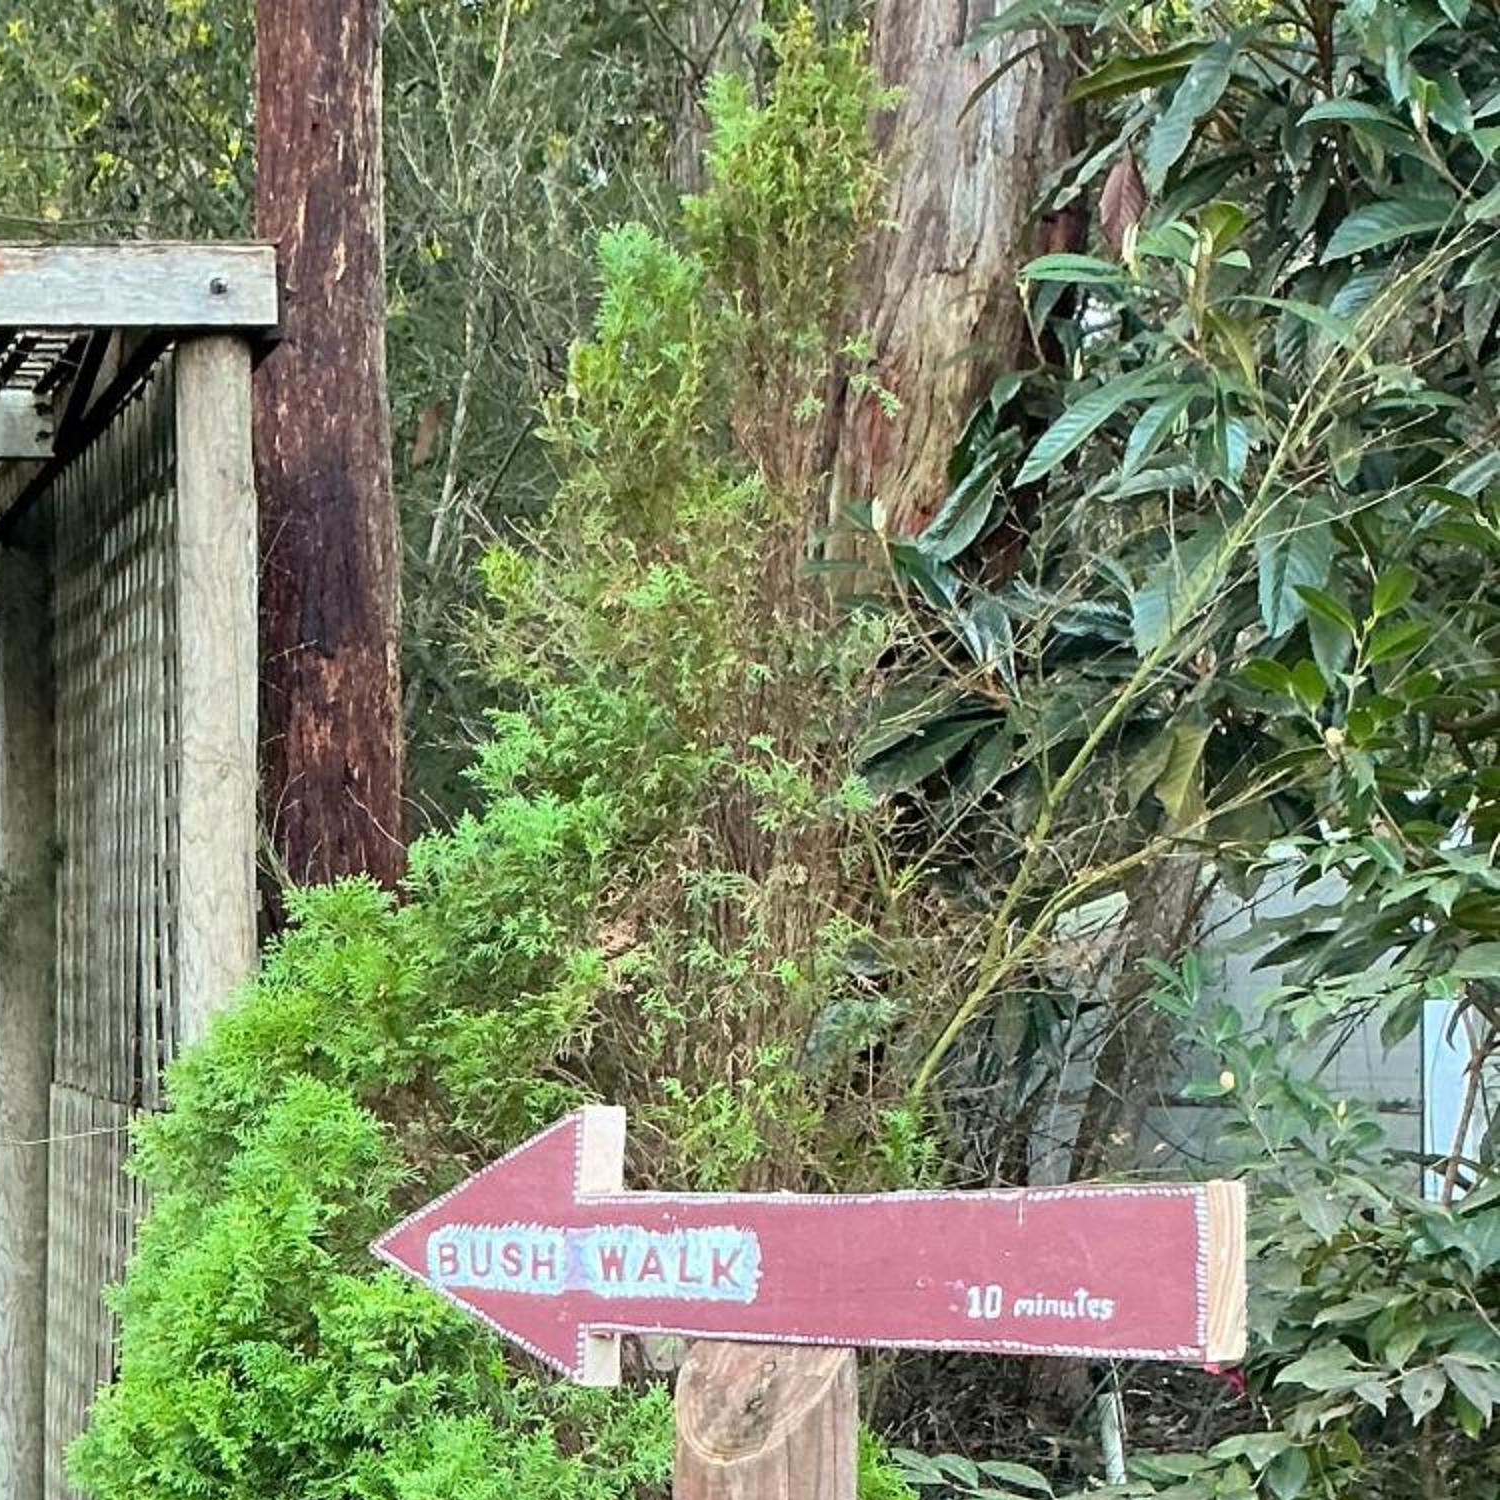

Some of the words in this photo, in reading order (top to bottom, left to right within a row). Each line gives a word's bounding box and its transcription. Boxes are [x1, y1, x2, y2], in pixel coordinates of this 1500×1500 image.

[438, 1241, 557, 1281] BUSH
[600, 1245, 742, 1288] WALK
[967, 1284, 1003, 1319] 10
[1013, 1287, 1115, 1321] minutes
